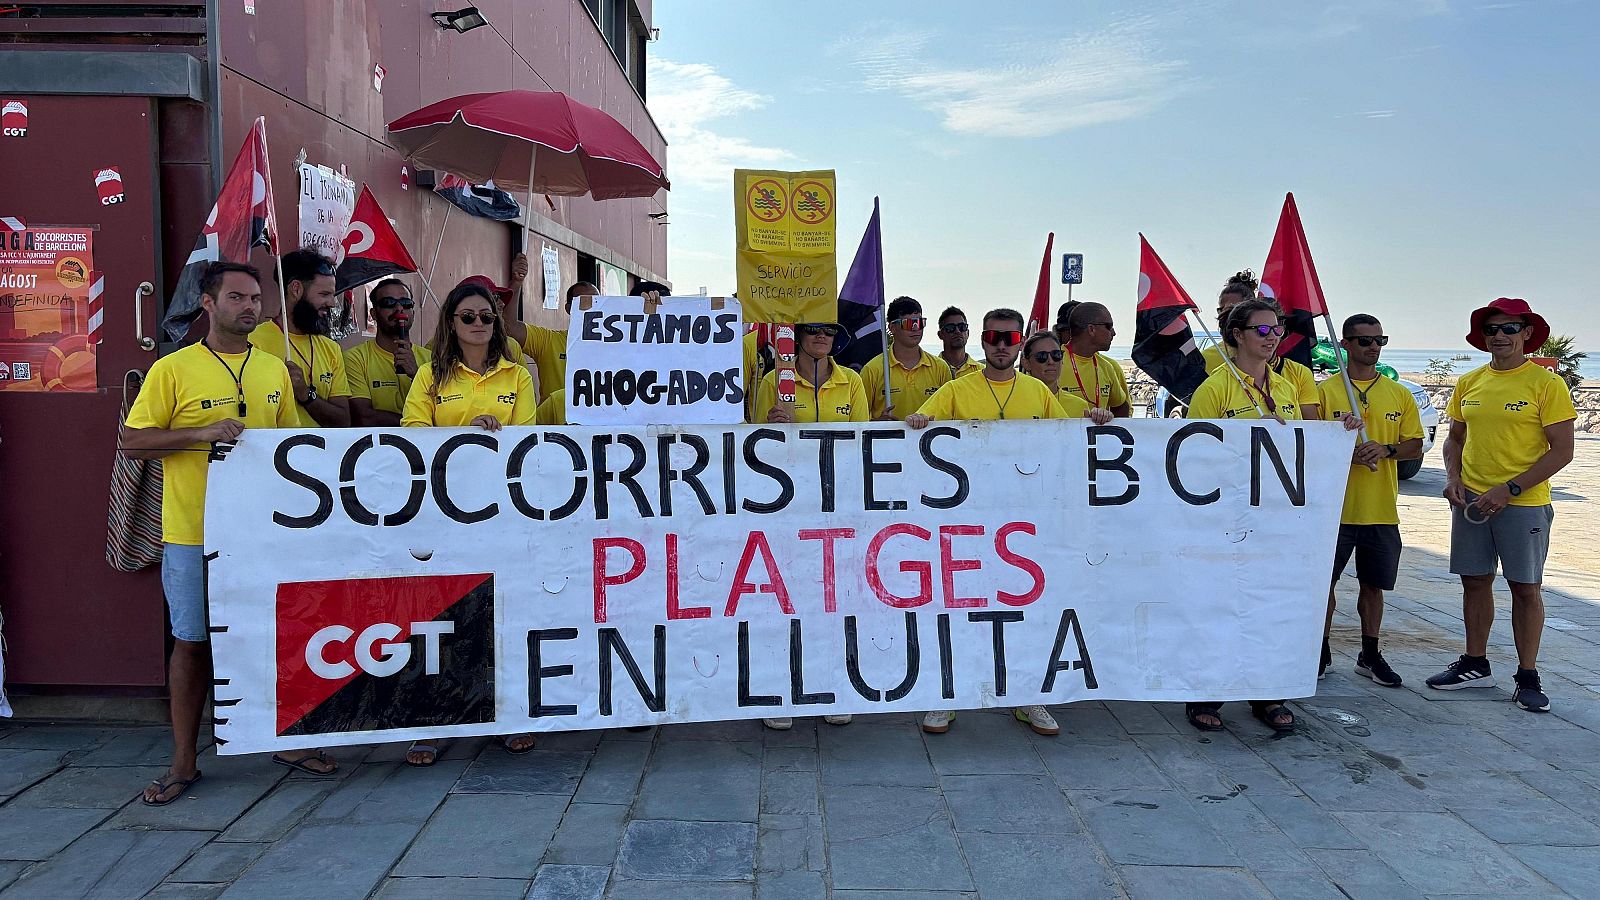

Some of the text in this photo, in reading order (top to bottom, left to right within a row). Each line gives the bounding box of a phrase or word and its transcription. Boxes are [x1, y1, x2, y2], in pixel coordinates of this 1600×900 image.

[3, 128, 27, 136] CGT
[101, 194, 124, 205] CGT
[303, 168, 315, 200] EL
[35, 232, 87, 243] SOCORRISTES
[46, 243, 87, 251] BARCELONA
[1068, 258, 1077, 269] P
[0, 274, 37, 288] AGOST
[582, 311, 738, 344] ESTAMOS
[572, 368, 744, 408] AHOGADOS
[273, 427, 970, 529] SOCORRISTES
[592, 521, 1046, 623] PLATGES
[305, 620, 454, 680] CGT
[527, 608, 1099, 717] EN LLUITA
